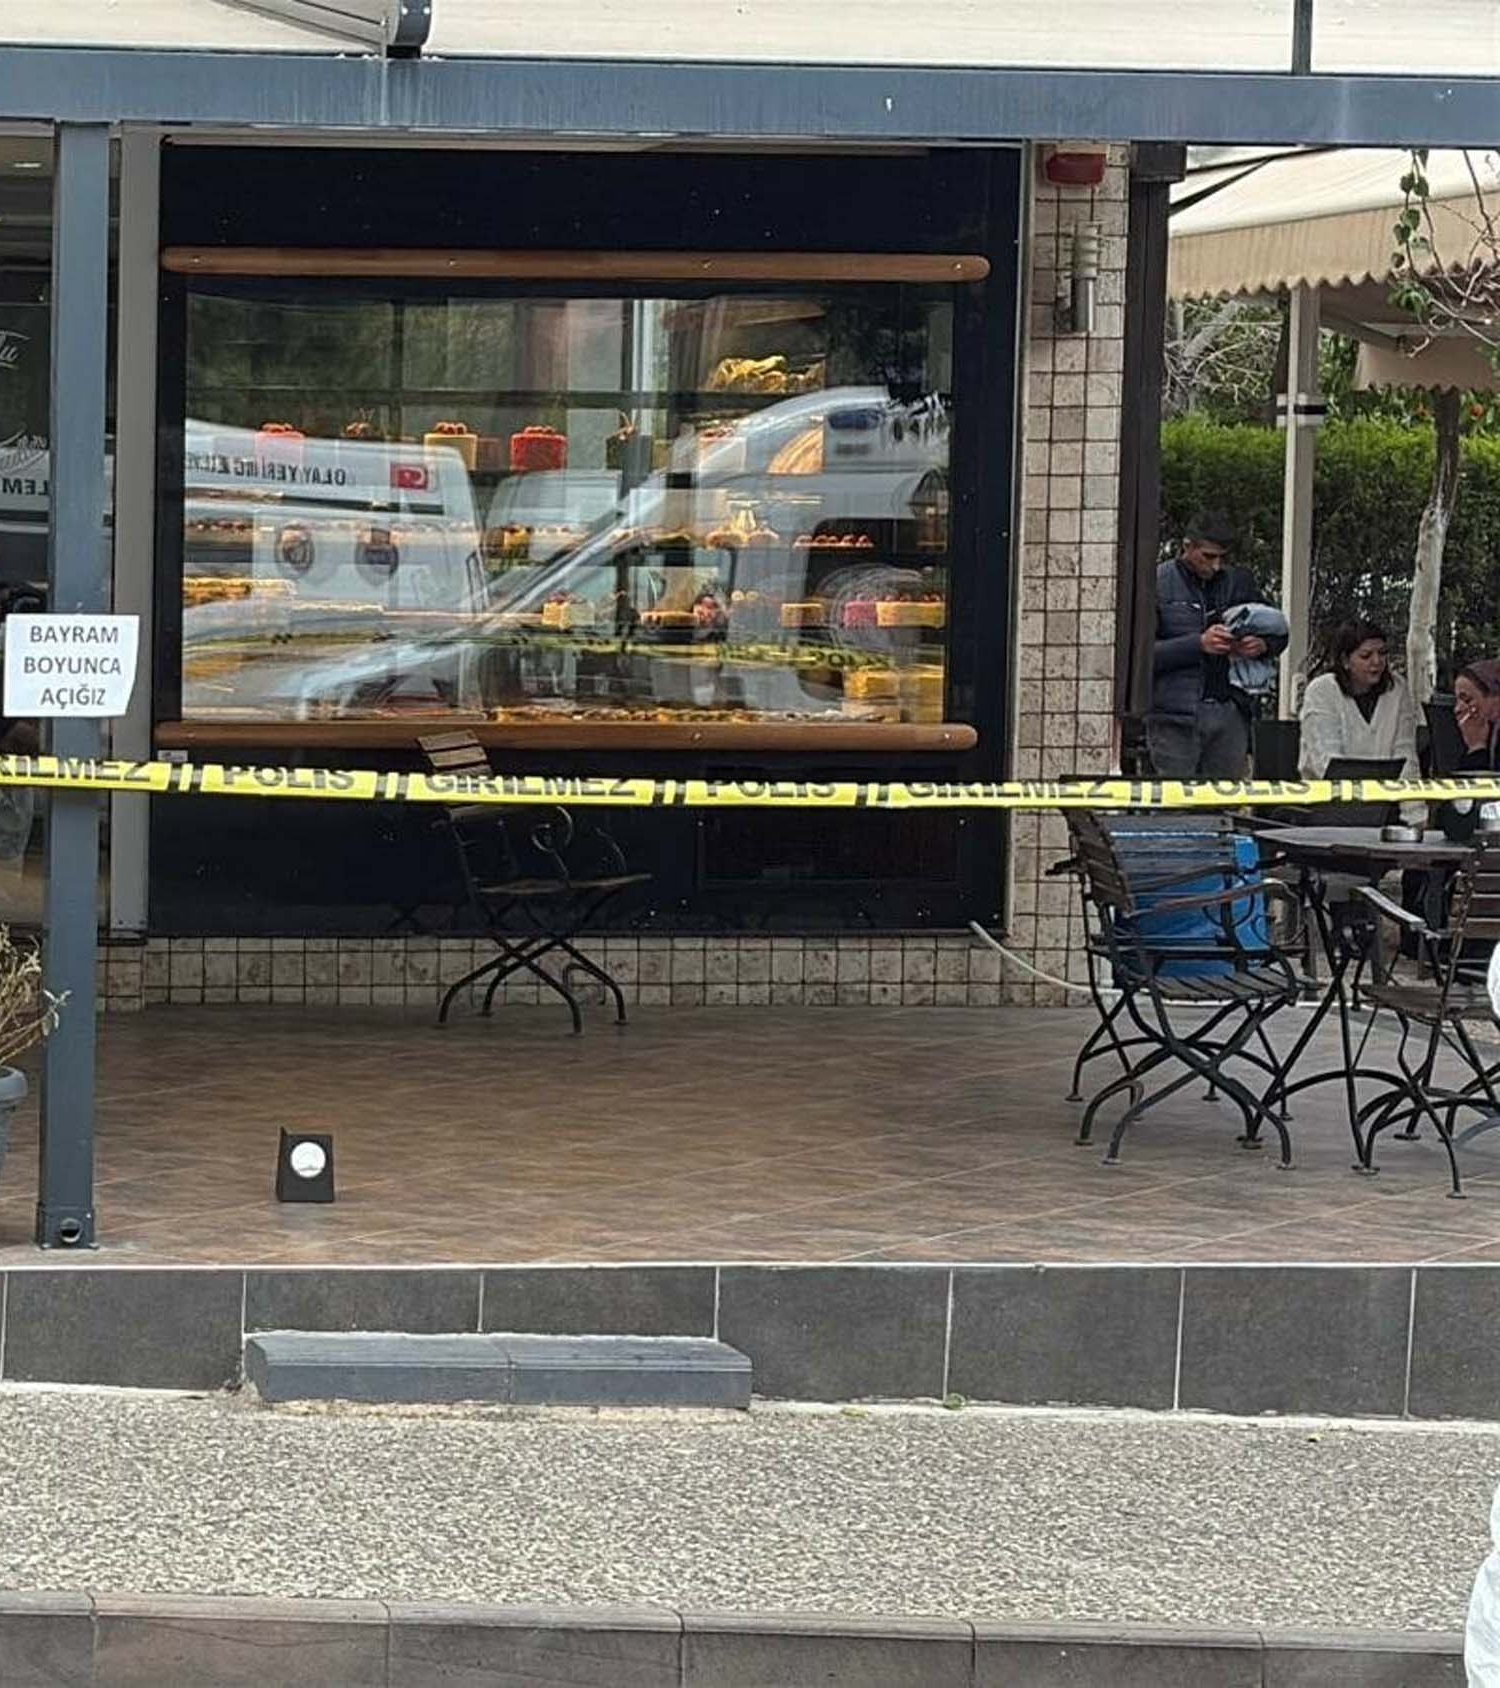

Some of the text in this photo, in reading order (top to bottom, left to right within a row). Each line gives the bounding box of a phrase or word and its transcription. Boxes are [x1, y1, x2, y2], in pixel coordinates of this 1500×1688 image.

[30, 625, 119, 644] BAYRAM
[24, 656, 122, 675] BOYUNCA
[40, 683, 106, 709] AÇIĞIZ
